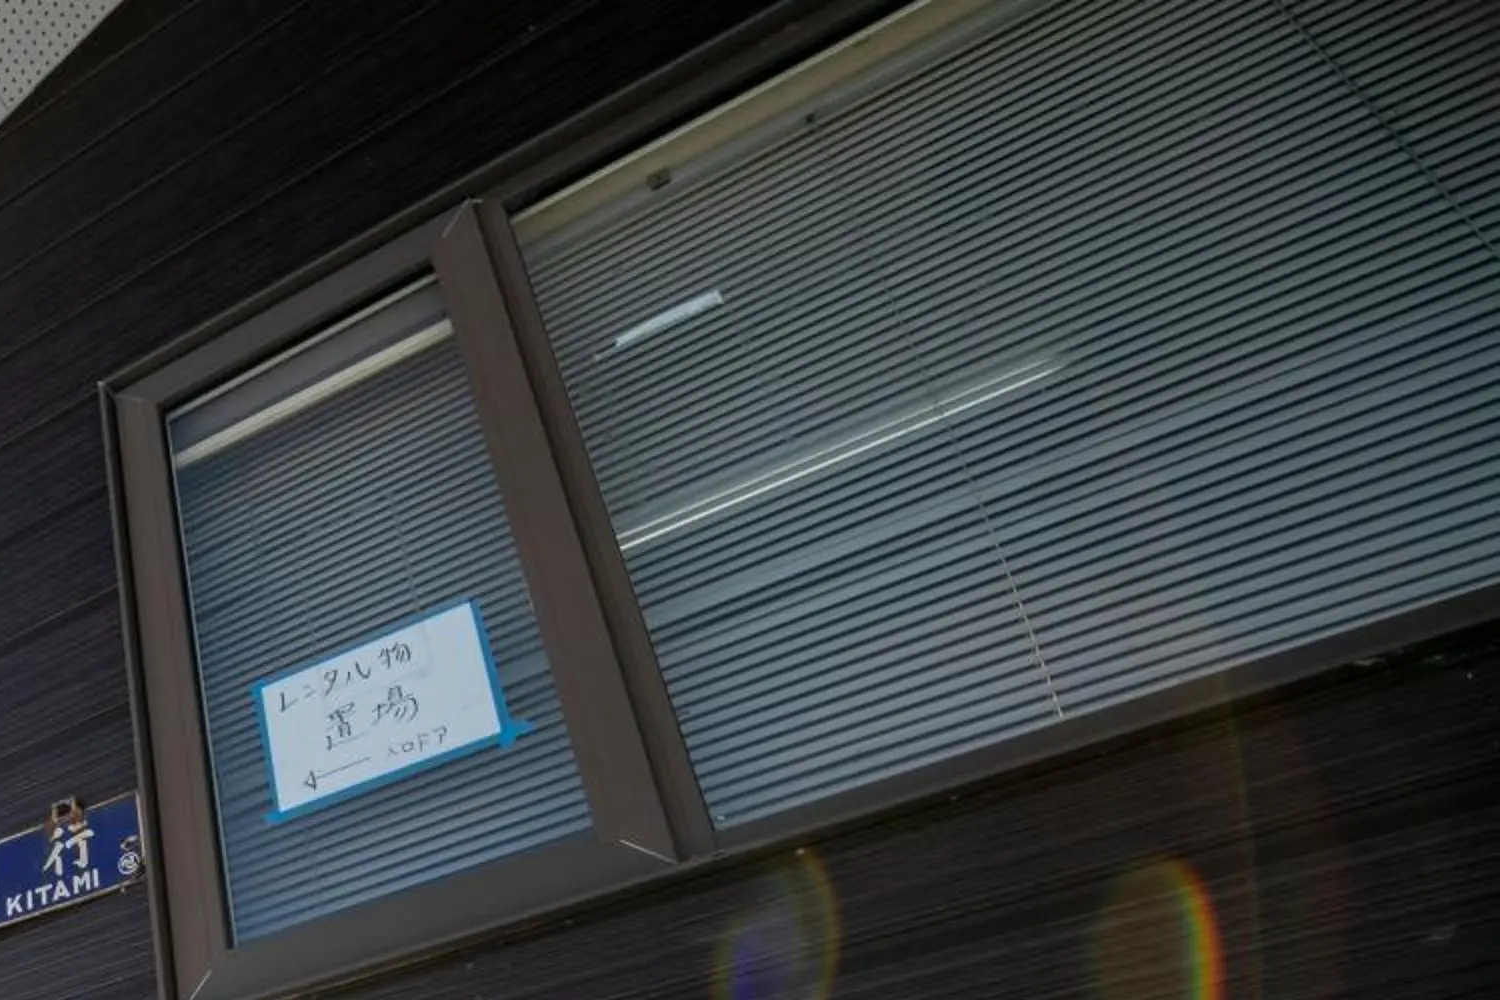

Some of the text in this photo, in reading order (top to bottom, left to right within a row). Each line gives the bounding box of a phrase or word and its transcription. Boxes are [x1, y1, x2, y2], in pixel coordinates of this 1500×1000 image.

[279, 642, 411, 713] レンタル物
[325, 685, 419, 750] 置場
[6, 868, 99, 917] KITAMI
